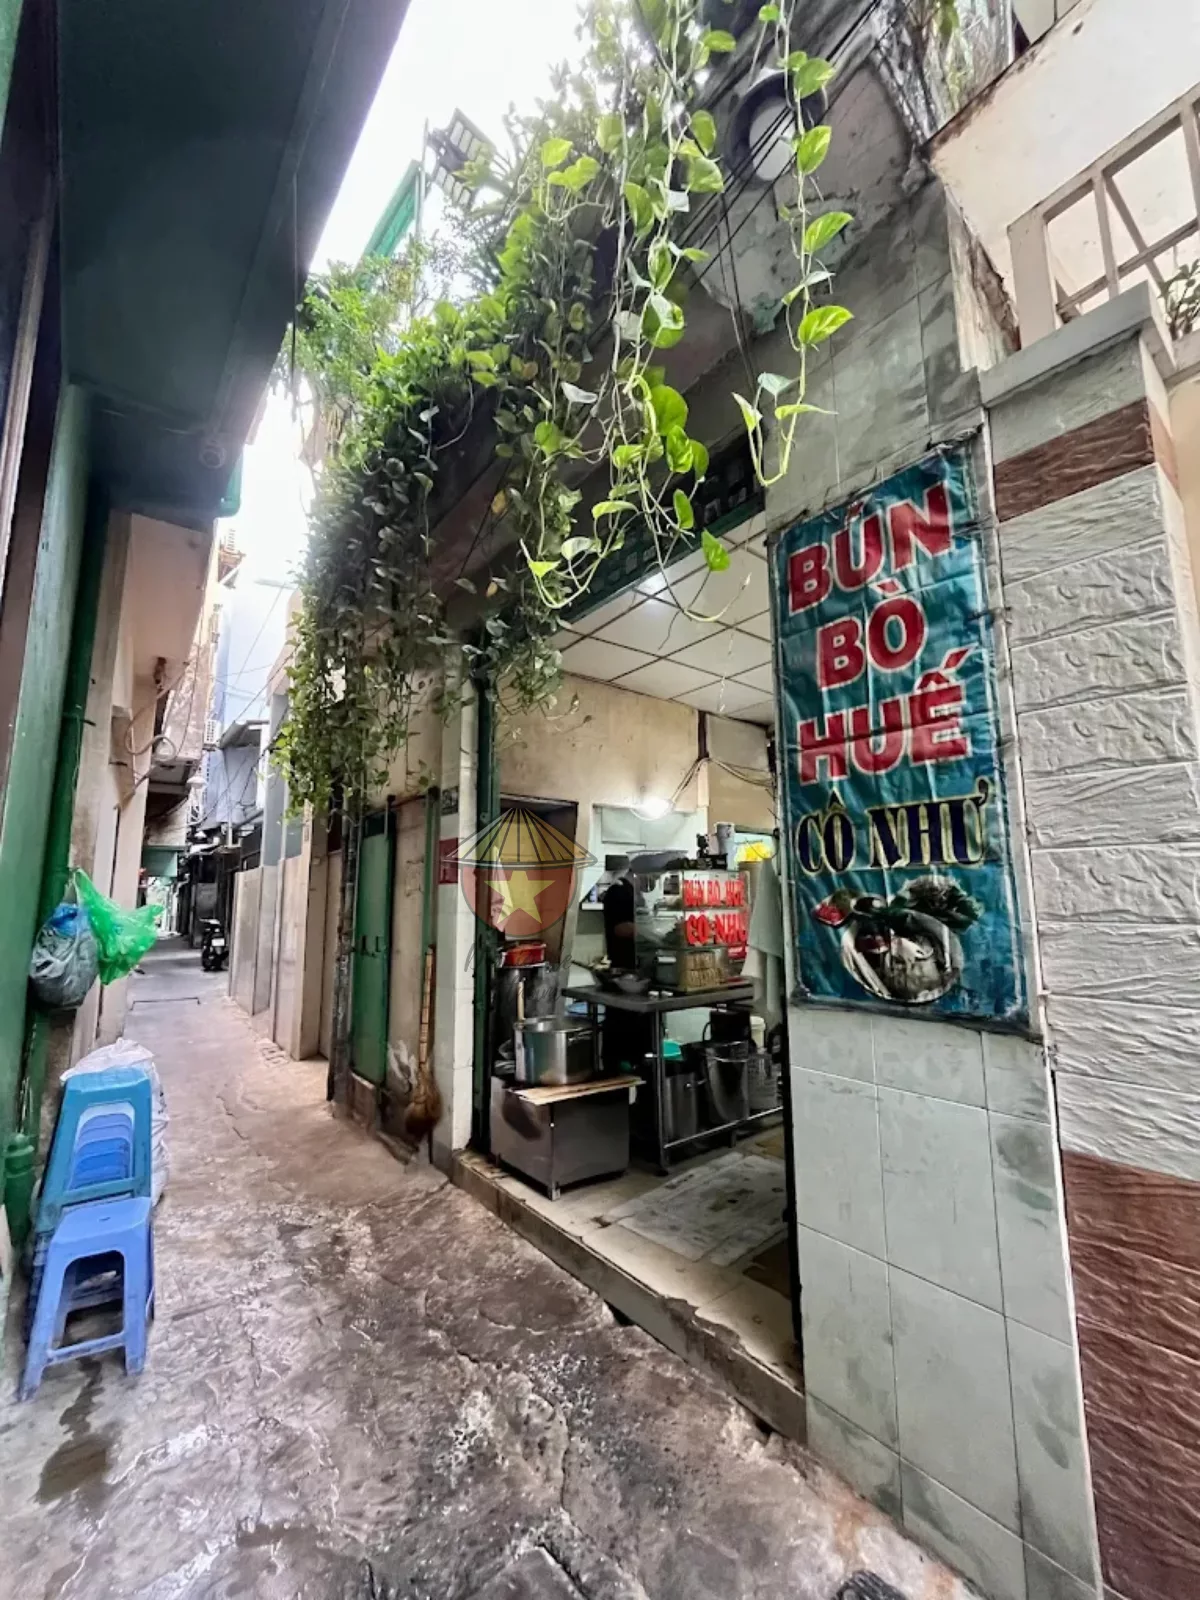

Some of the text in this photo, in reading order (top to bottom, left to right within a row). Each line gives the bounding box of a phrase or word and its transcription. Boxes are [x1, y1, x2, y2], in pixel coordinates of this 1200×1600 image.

[787, 482, 953, 616] BÚN
[815, 577, 929, 691] BÒ
[796, 644, 978, 785] HUẾ
[796, 775, 992, 876] CÔ NHƯ
